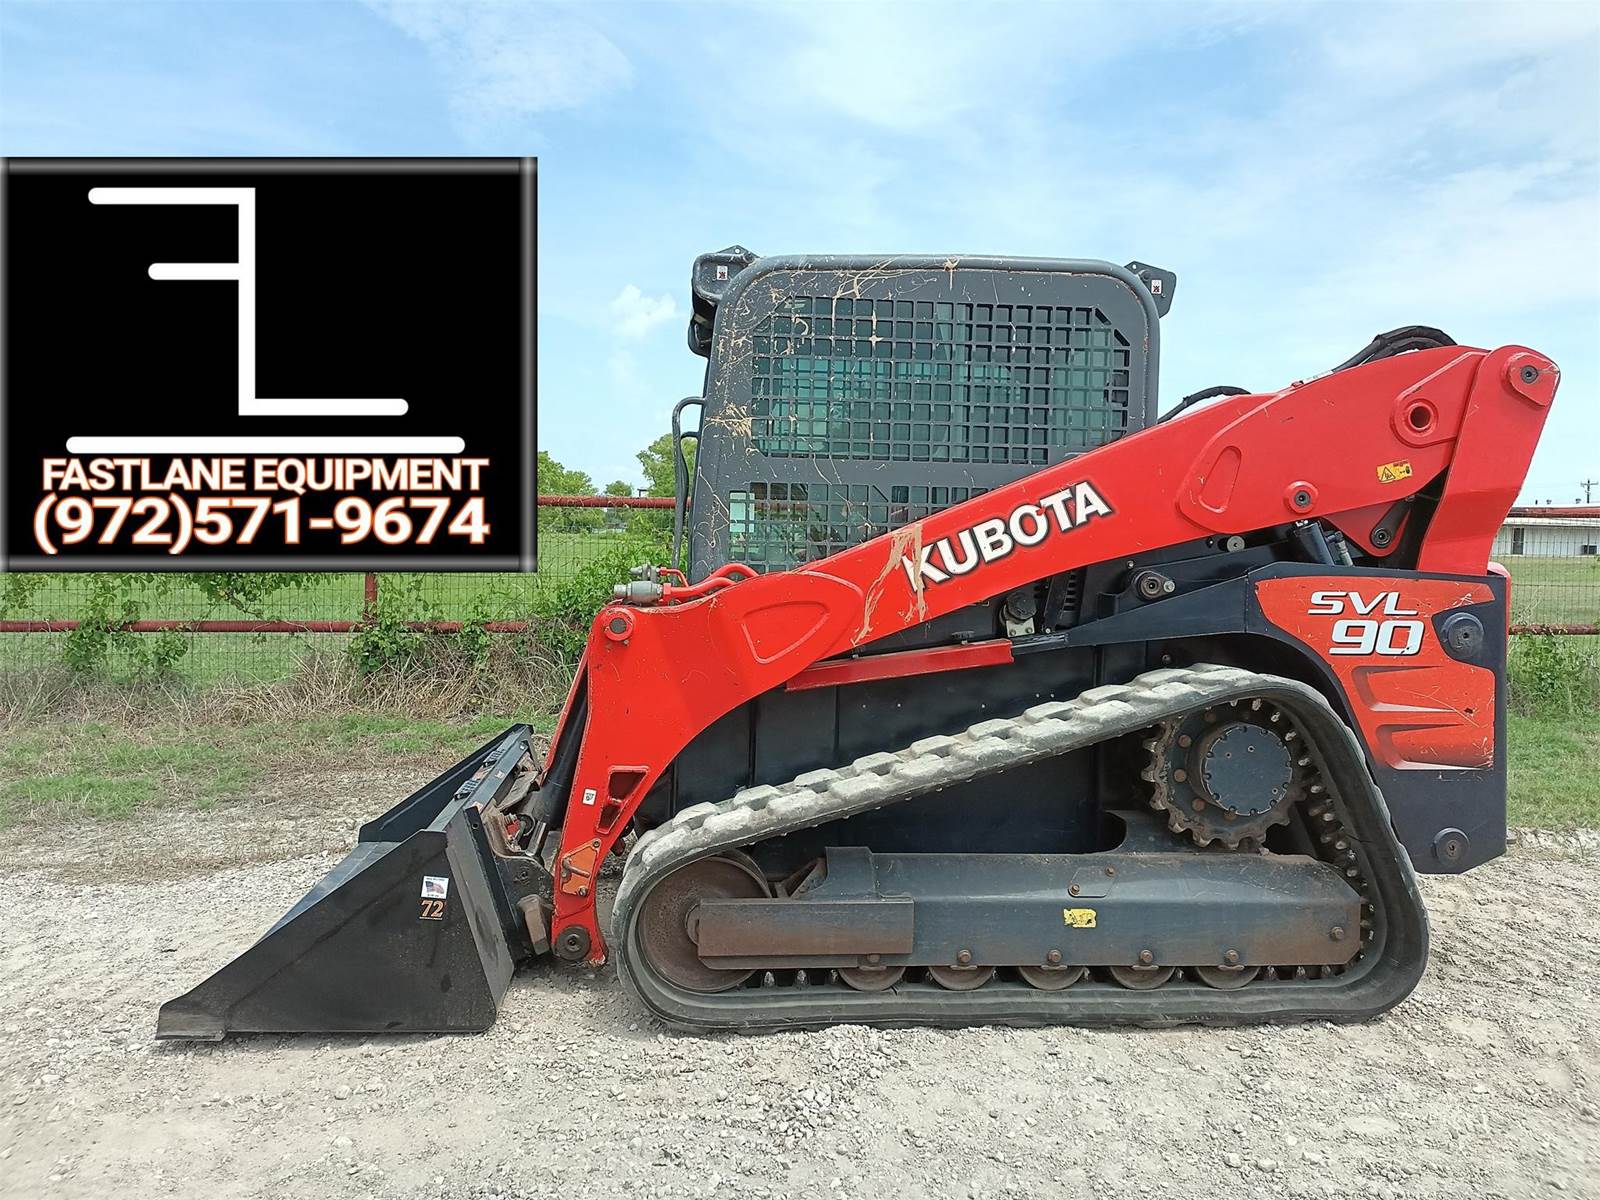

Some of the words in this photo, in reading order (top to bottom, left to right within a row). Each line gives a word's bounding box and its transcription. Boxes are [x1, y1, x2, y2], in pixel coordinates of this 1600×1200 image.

[901, 481, 1113, 593] KUBOTA
[1307, 591, 1419, 616] SVL
[1328, 619, 1425, 656] 90
[421, 900, 445, 918] 72
